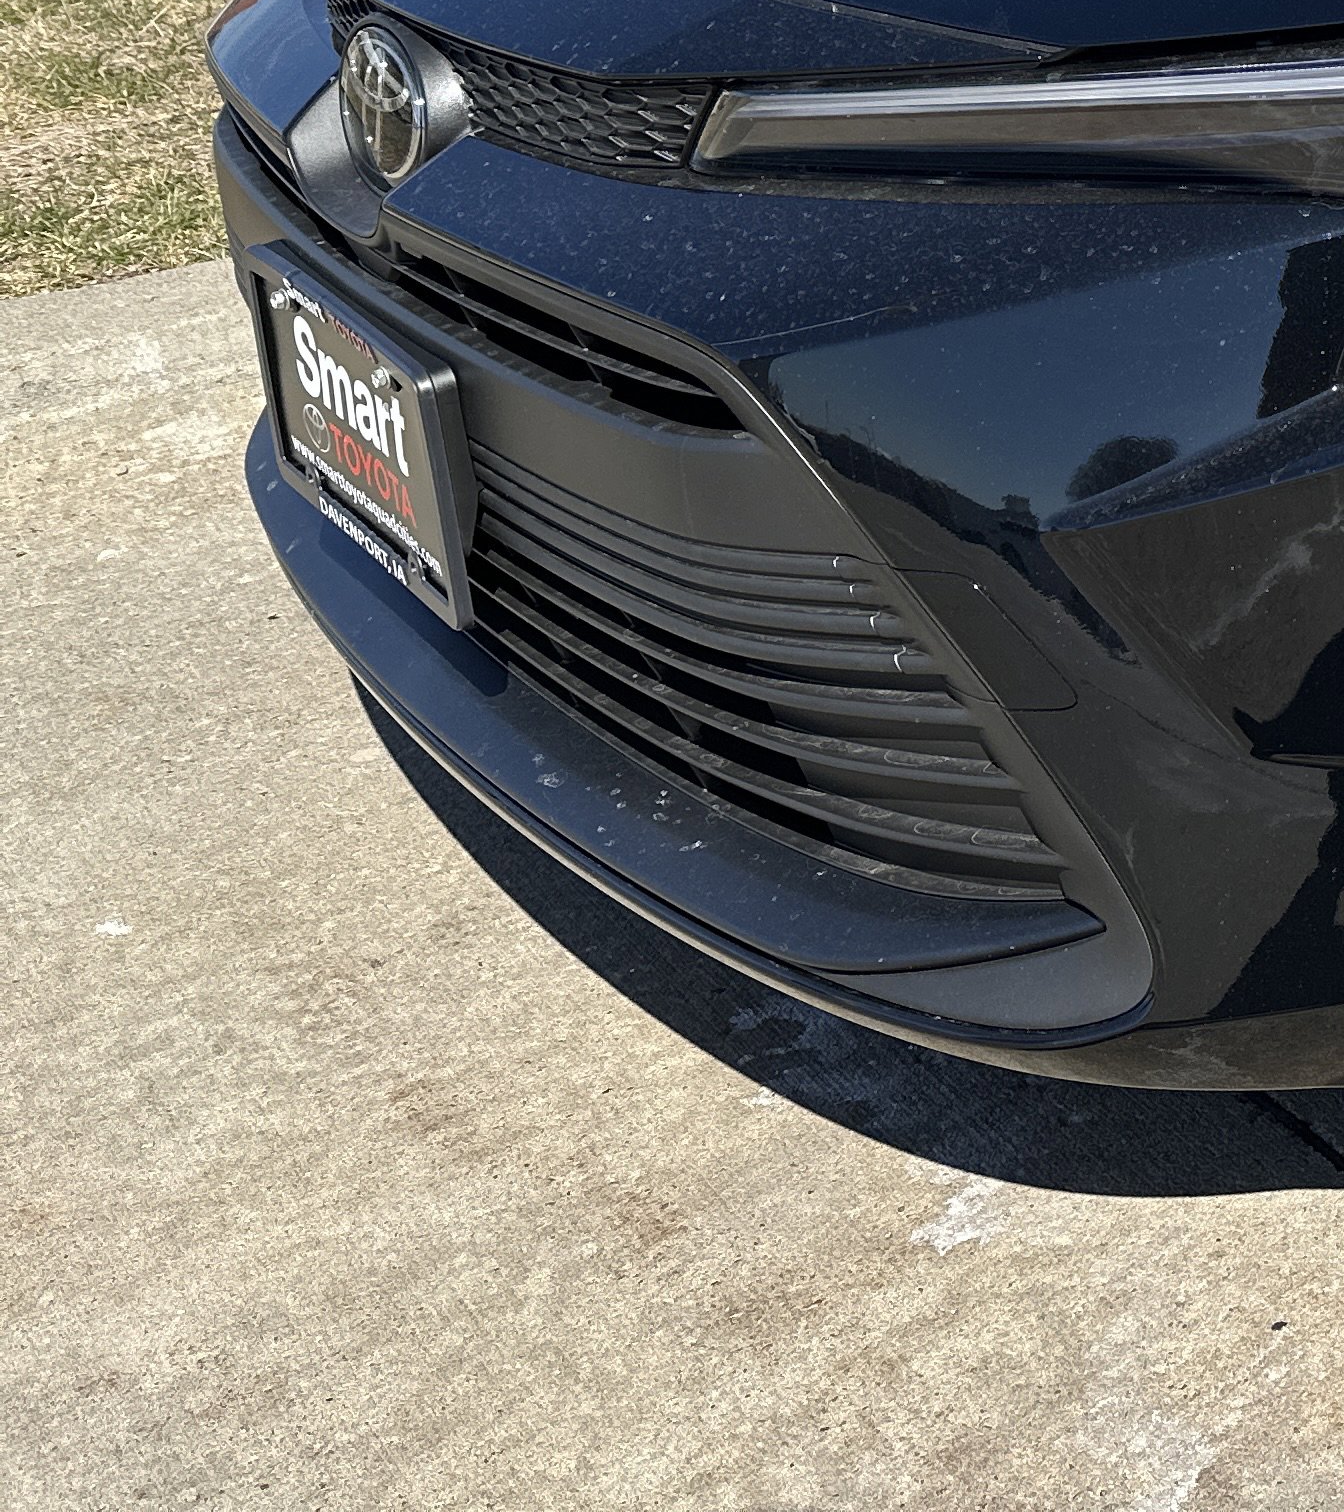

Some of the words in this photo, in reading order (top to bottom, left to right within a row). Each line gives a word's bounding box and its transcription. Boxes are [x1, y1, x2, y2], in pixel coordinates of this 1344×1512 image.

[282, 277, 326, 323] Smart
[328, 313, 379, 365] TOYOTA
[292, 314, 411, 477] Smart
[290, 434, 443, 577] www.smarttoyotaquadcities.com
[329, 422, 418, 528] TOYOTA
